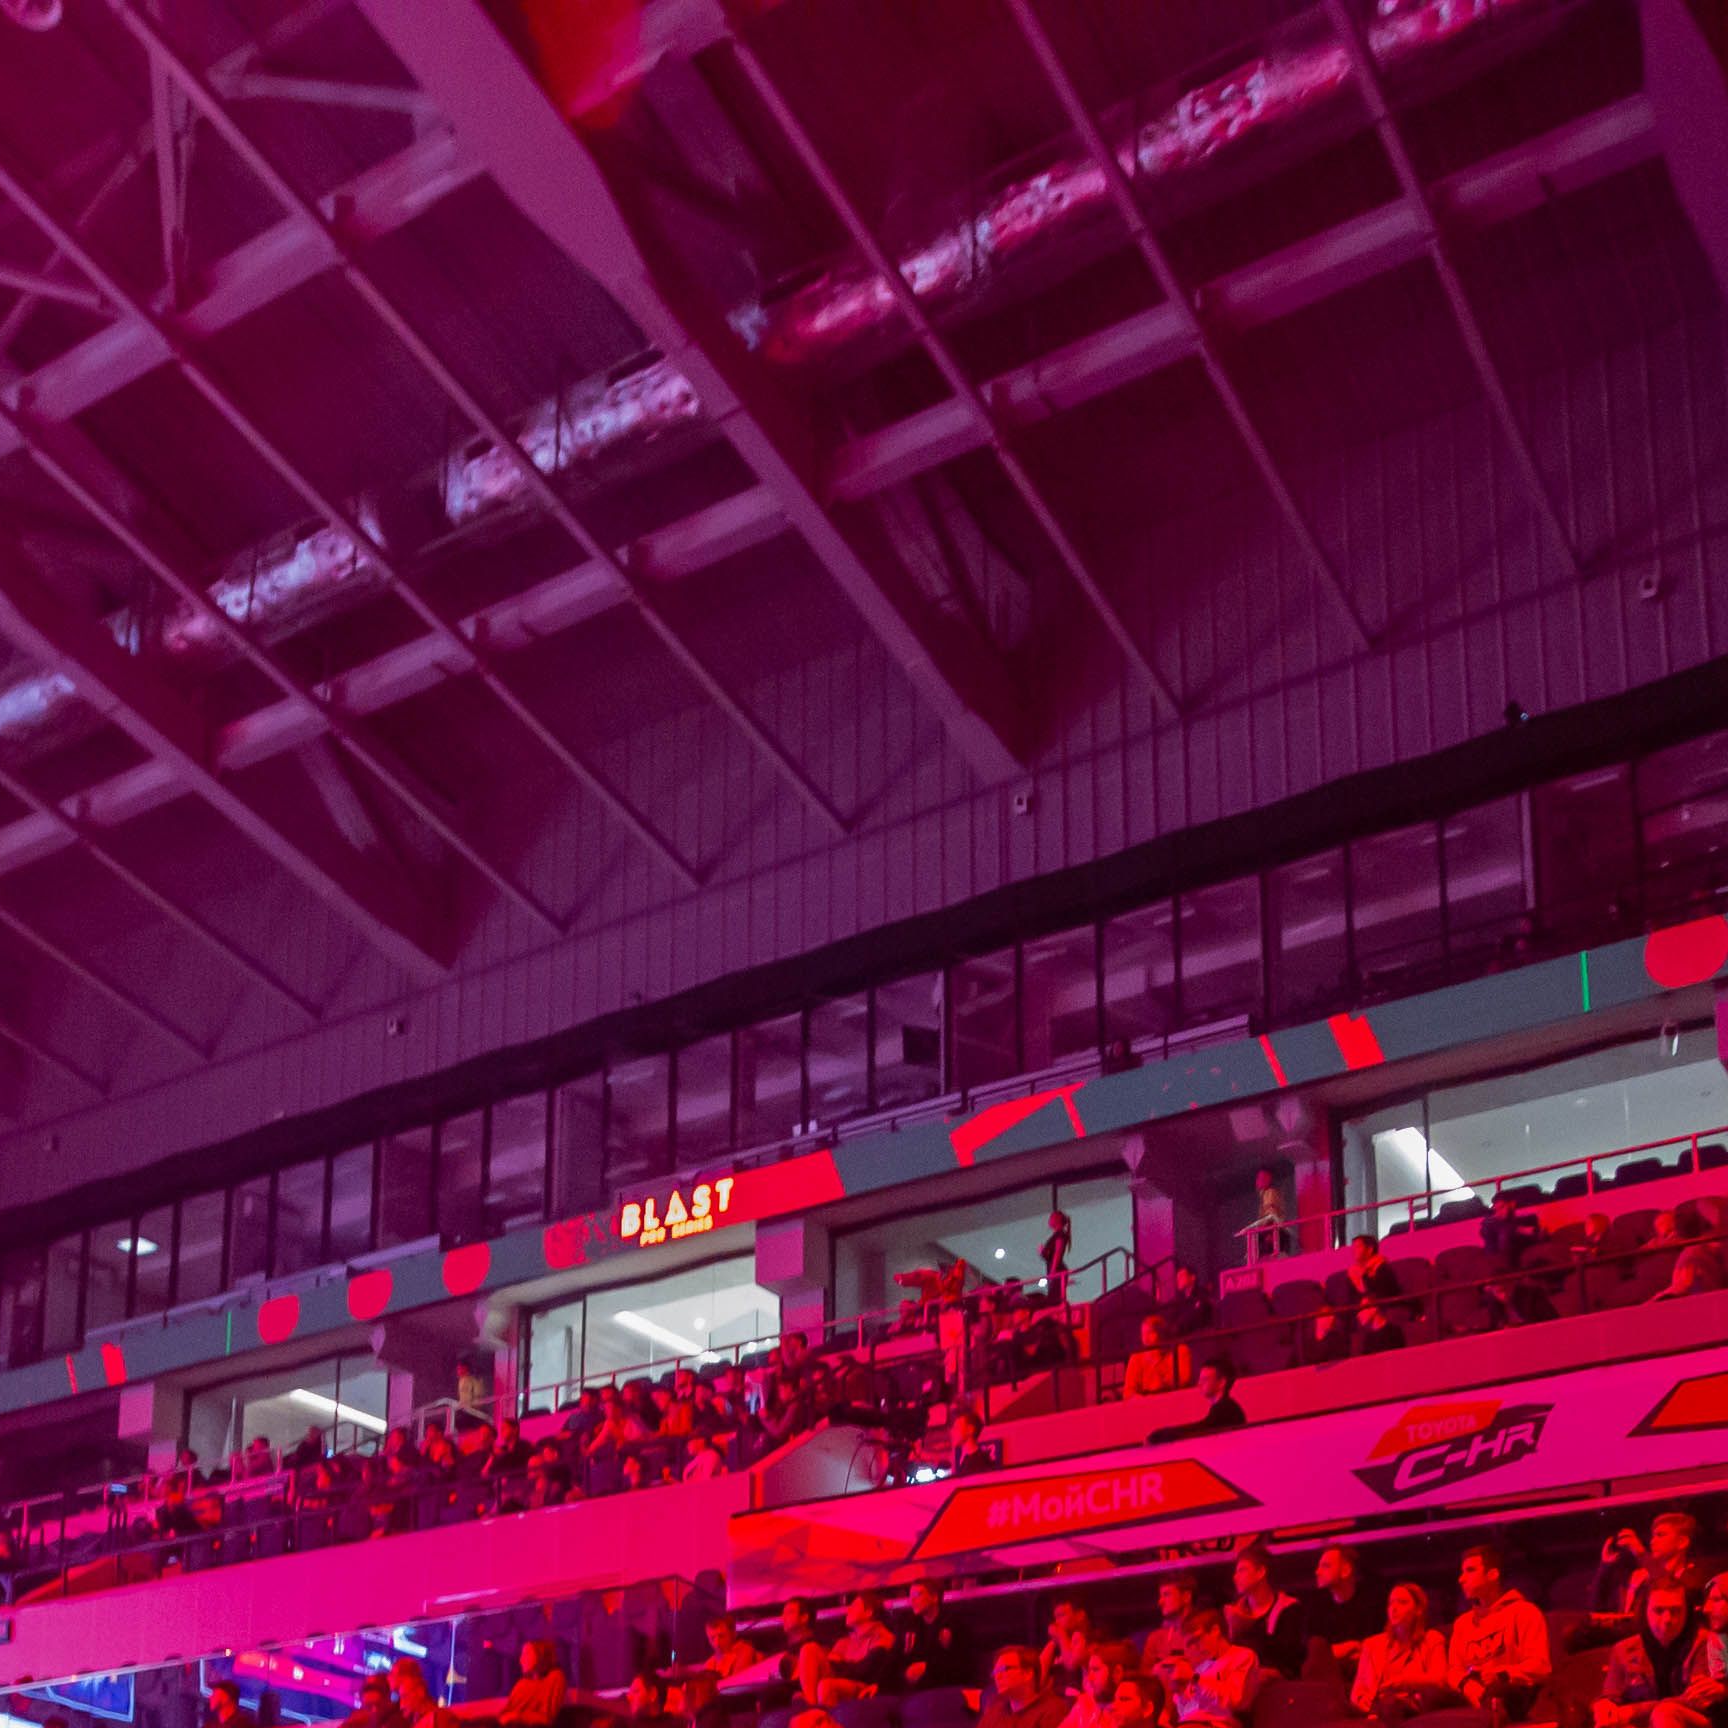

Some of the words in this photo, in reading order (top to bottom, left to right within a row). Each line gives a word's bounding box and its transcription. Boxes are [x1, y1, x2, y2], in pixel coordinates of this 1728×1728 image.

[621, 1178, 734, 1237] BLAST
[1393, 1422, 1535, 1490] C-HR
[1406, 1415, 1478, 1443] TOYOTA
[986, 1472, 1165, 1529] #МойCHR
